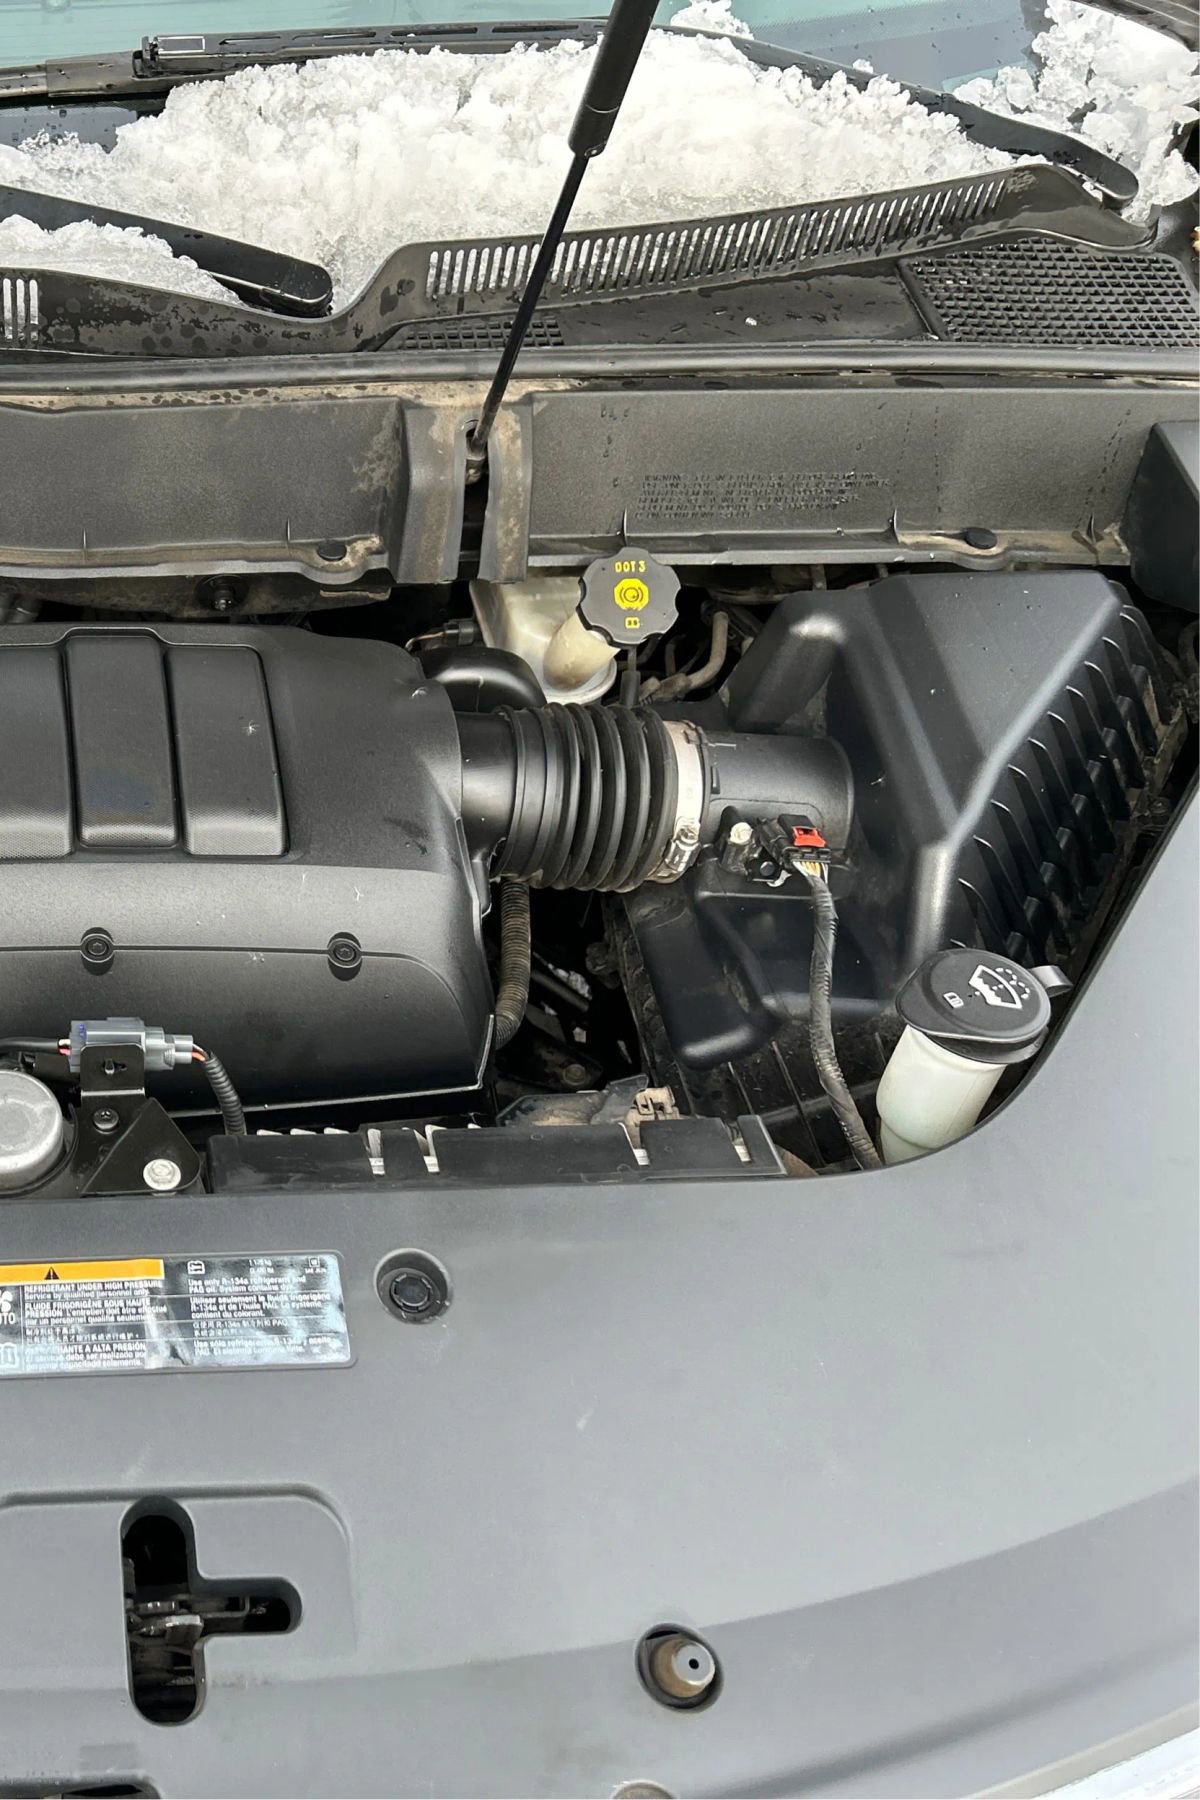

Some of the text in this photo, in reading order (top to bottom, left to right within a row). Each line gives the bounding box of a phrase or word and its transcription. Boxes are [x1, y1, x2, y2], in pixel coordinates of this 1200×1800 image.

[24, 1282, 75, 1293] REFRIGERANT
[76, 1281, 103, 1292] UNDER
[104, 1280, 123, 1290] HIGH
[25, 1301, 51, 1311] FLUIDE
[92, 1343, 111, 1353] ALTA
